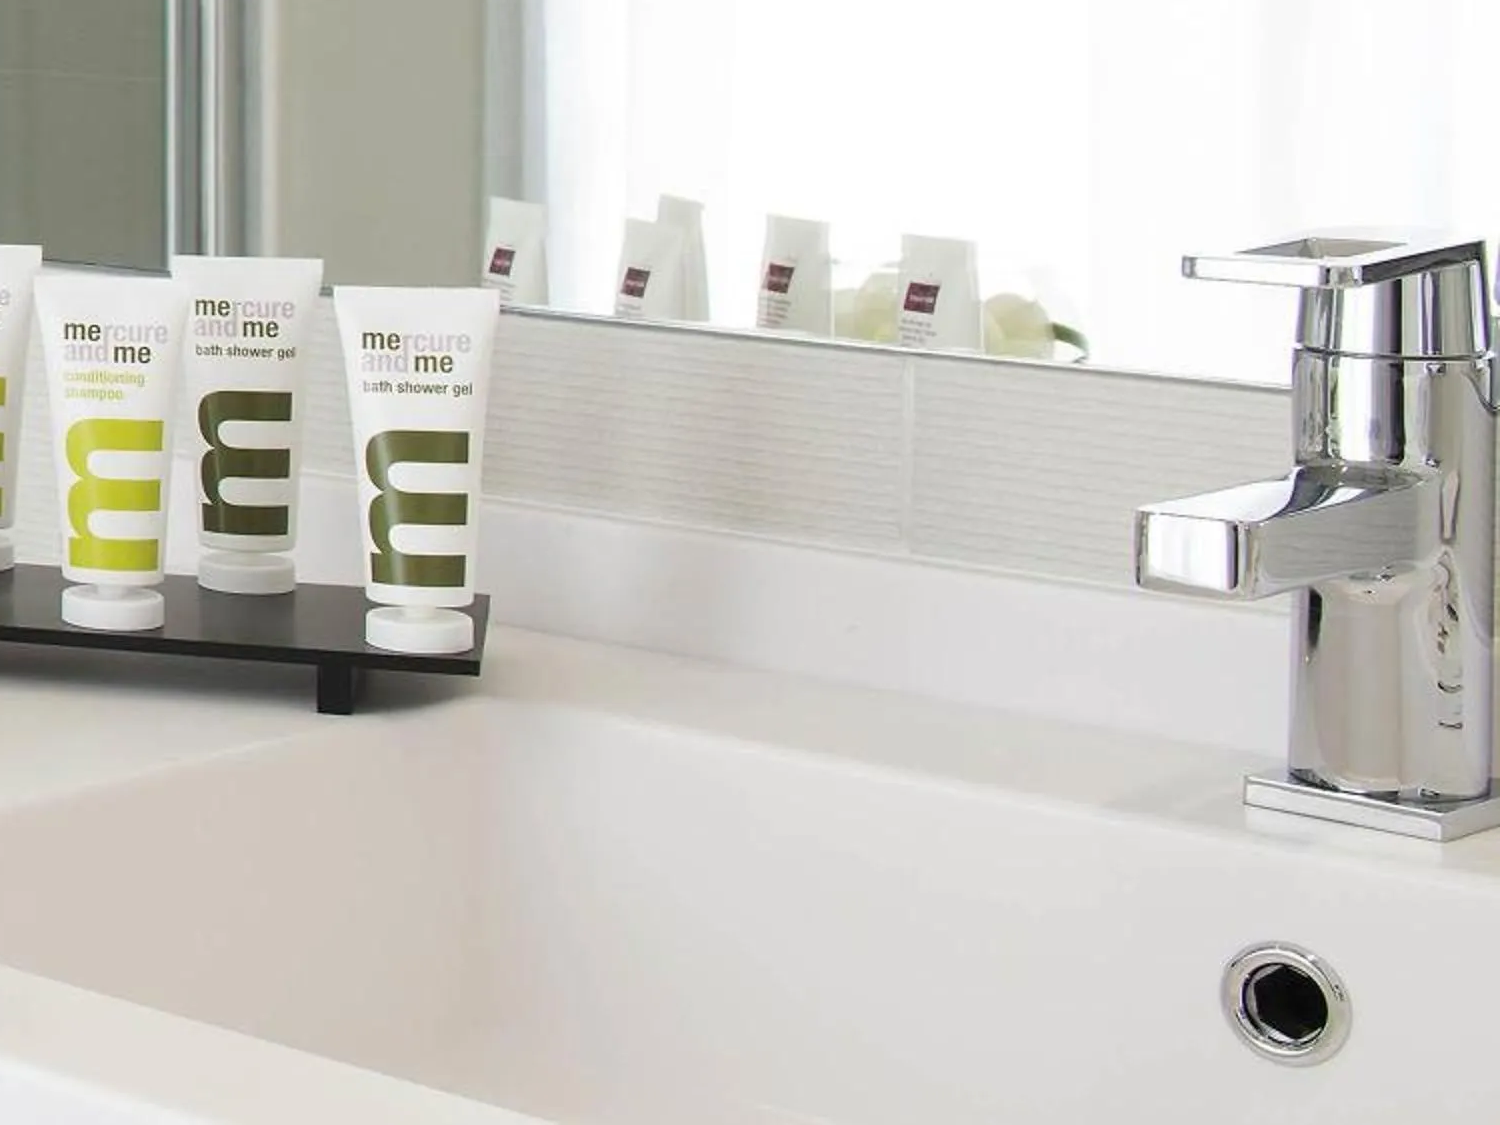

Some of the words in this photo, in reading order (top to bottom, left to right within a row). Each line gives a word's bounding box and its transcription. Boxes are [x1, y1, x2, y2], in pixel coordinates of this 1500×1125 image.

[195, 299, 296, 319] mercure
[64, 322, 168, 344] mercure
[195, 315, 238, 337] and
[242, 320, 279, 338] me
[63, 342, 109, 362] and
[113, 345, 151, 364] me
[195, 344, 223, 356] bath
[226, 345, 274, 358] shower
[277, 347, 297, 361] gel
[362, 332, 472, 353] mercure
[361, 352, 408, 373] and
[414, 355, 454, 373] me
[362, 380, 393, 393] bath
[396, 380, 449, 394] shower
[452, 383, 474, 398] gel
